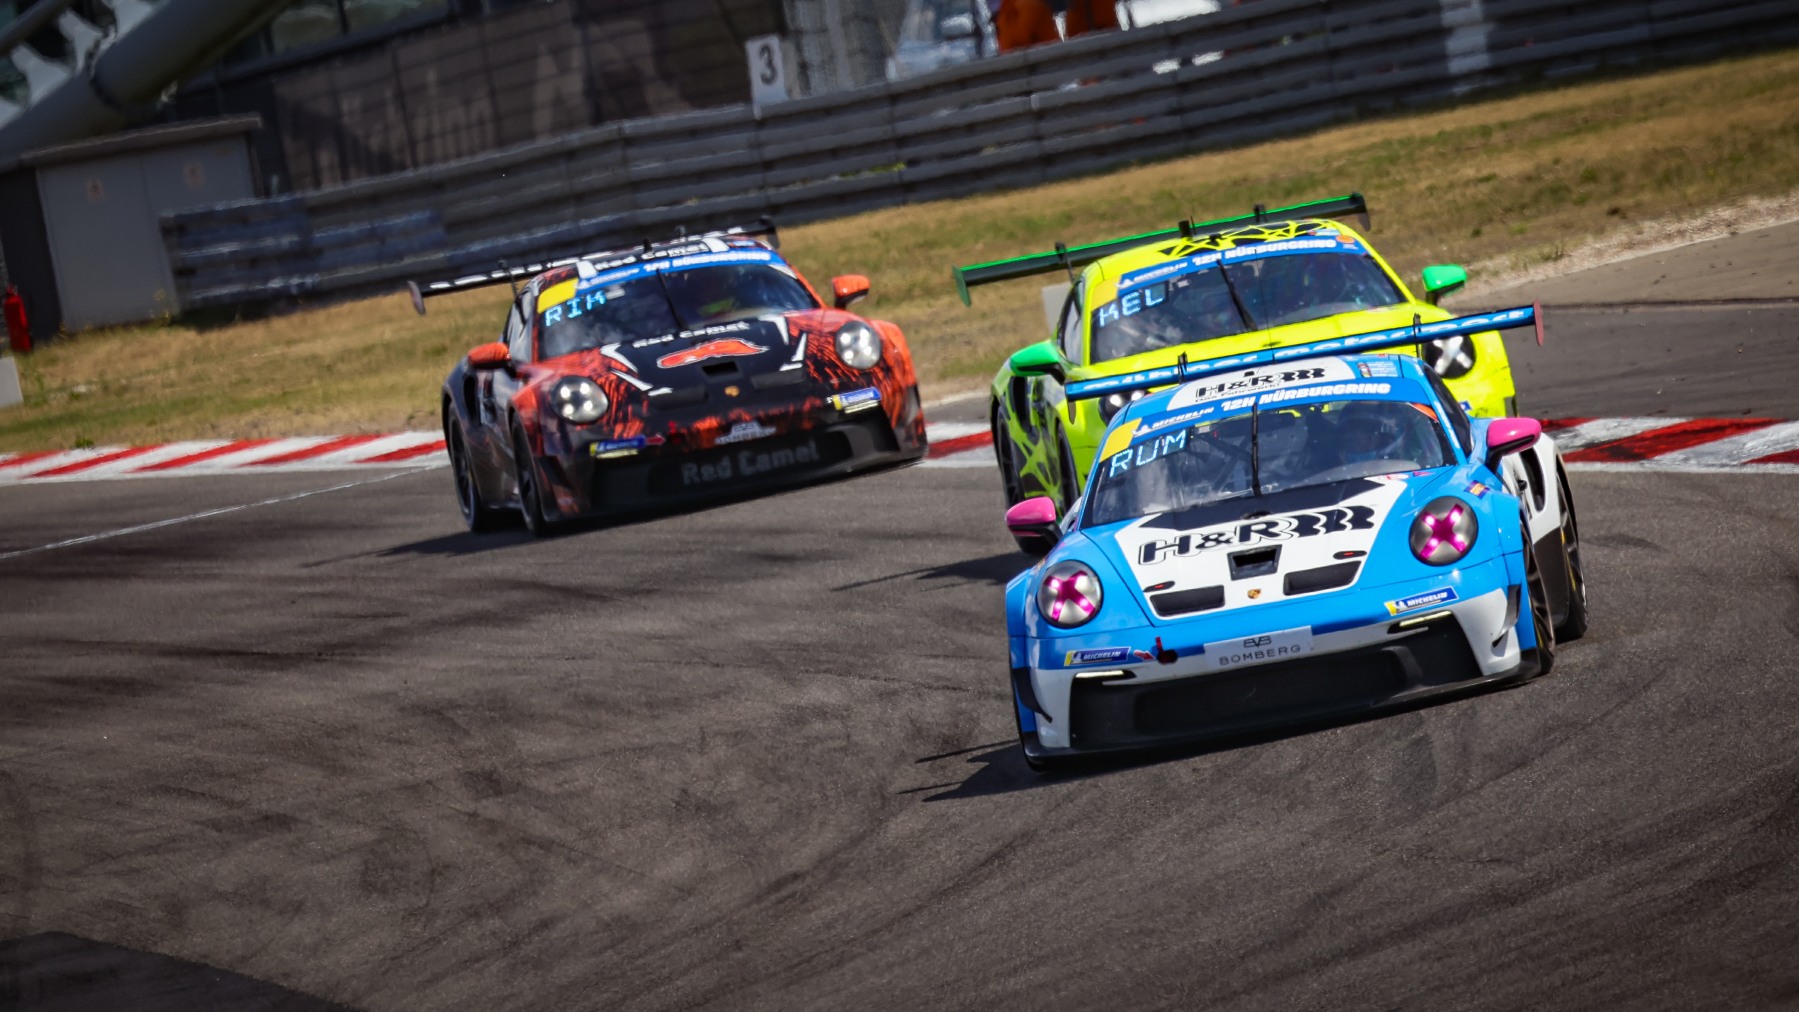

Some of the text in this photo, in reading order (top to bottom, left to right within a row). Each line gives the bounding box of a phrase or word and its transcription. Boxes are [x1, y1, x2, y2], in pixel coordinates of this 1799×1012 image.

[759, 44, 778, 85] 3
[1151, 381, 1391, 429] MICHELIN 12H NÜRBURGRING
[680, 442, 821, 486] Red Camel
[1109, 428, 1187, 479] RUM
[1406, 591, 1449, 608] MICHELIN
[1081, 650, 1122, 662] MICHELIN
[1218, 643, 1302, 667] BOMBERG
